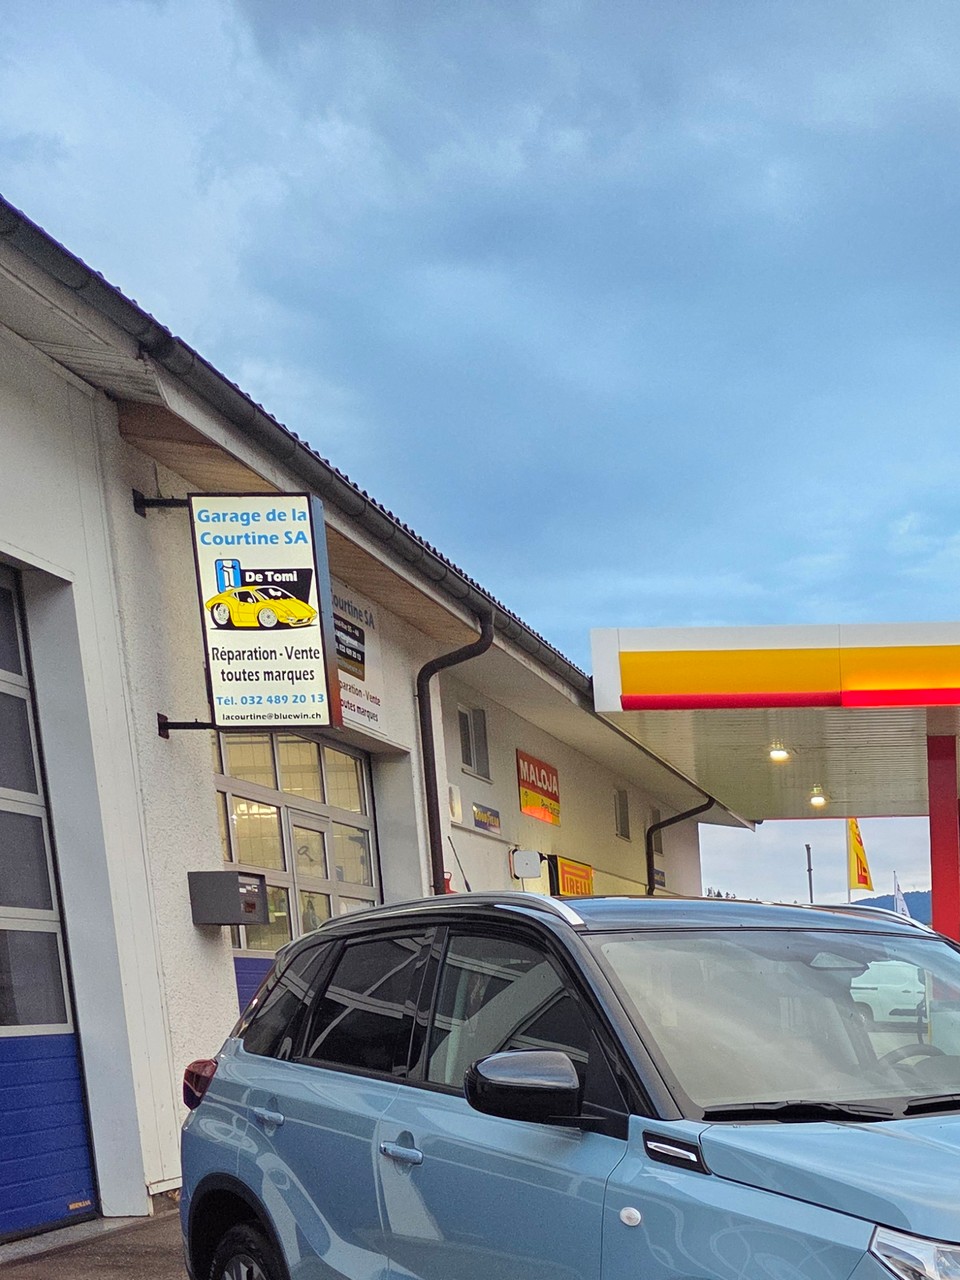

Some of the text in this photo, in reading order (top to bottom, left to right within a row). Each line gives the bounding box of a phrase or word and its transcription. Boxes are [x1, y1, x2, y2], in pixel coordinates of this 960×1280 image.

[197, 508, 307, 526] Garage de la
[200, 531, 308, 546] Courtine SA
[245, 572, 262, 582] De
[333, 594, 363, 622] ourtine
[364, 610, 375, 630] SA
[212, 646, 277, 665] Réparation
[284, 646, 320, 660] Vente
[220, 669, 315, 685] toutes marques
[216, 694, 324, 706] Tél. 032 489 20 13
[365, 690, 380, 706] Vente
[222, 712, 322, 721] lacourtine@bluewin.ch
[340, 699, 378, 722] outes marques
[520, 758, 558, 796] MALOJA
[560, 862, 592, 896] PIRELLI
